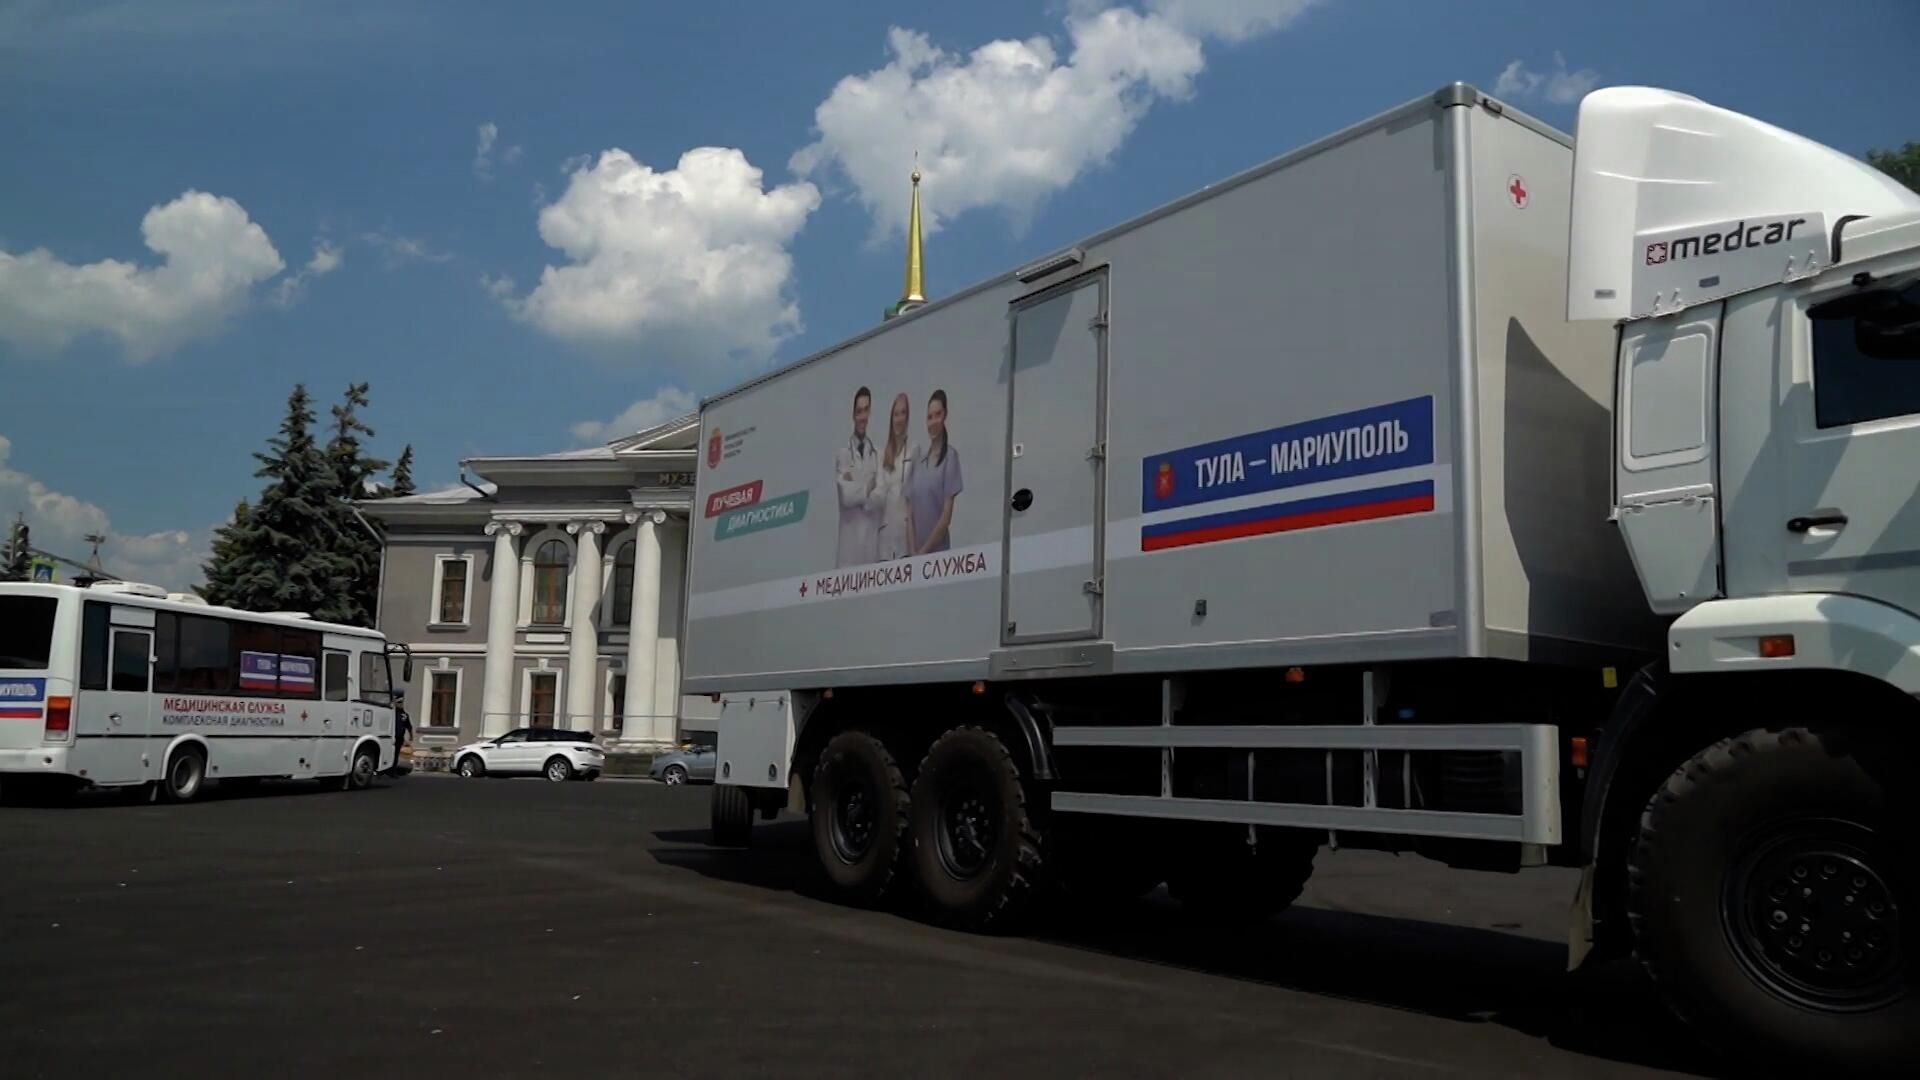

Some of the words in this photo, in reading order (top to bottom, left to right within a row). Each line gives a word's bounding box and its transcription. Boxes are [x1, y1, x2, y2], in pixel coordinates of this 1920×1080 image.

[1670, 218, 1806, 260] medcar
[1195, 451, 1245, 488] ТУЛА
[1271, 419, 1409, 475] МАРИУПОЛЬ
[712, 487, 754, 512] ЛУЧЕВАЯ
[726, 501, 795, 533] ДИАГНОСТИКА
[816, 563, 913, 597] МЕДИЦИНСКАЯ
[922, 552, 987, 580] СЛУЖБА
[163, 697, 246, 714] МЕДИЦИНСКАЯ
[247, 701, 286, 714] СЛУЖБА
